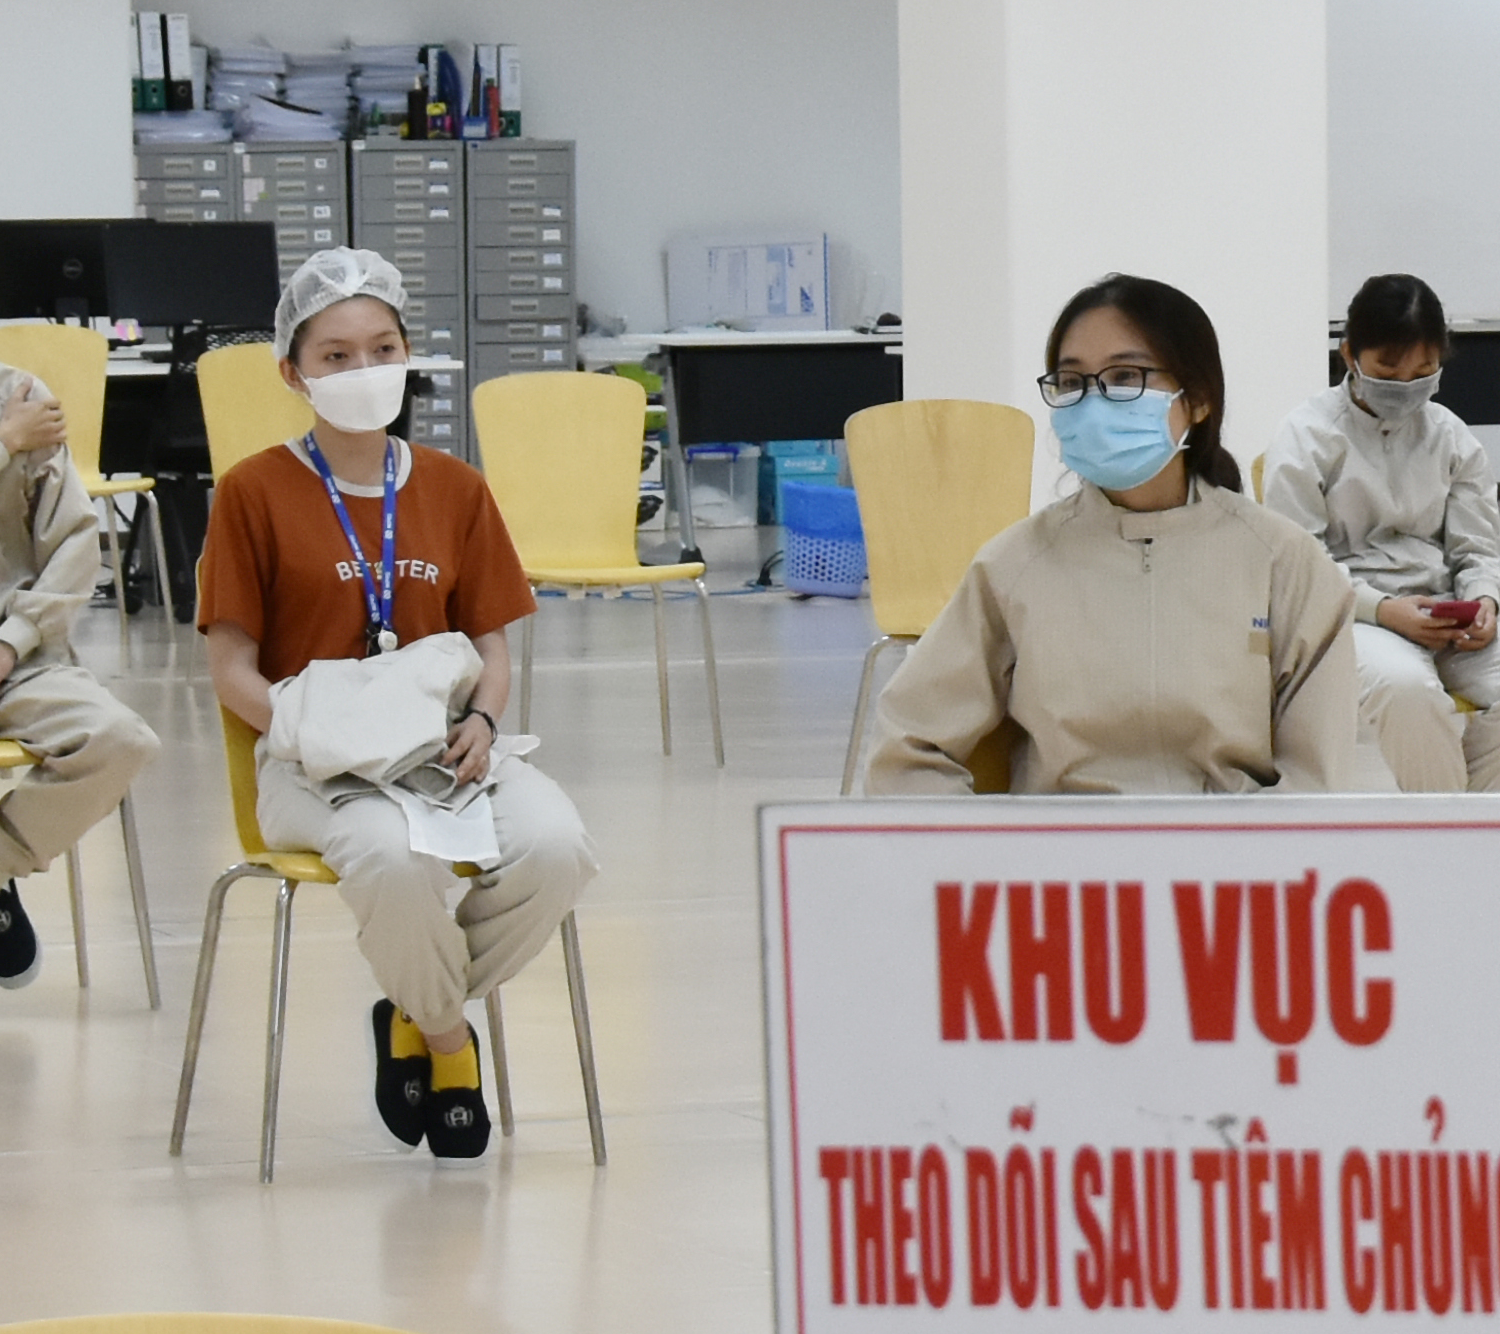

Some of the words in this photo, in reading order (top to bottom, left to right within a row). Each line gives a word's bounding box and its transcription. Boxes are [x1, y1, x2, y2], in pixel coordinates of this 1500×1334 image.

[935, 880, 1149, 1047] KHU
[1171, 869, 1396, 1086] VỰC
[817, 1143, 954, 1310] THEO
[964, 1107, 1063, 1312] DÕI
[1071, 1144, 1182, 1313] SAU
[1190, 1118, 1329, 1312] TIÊM
